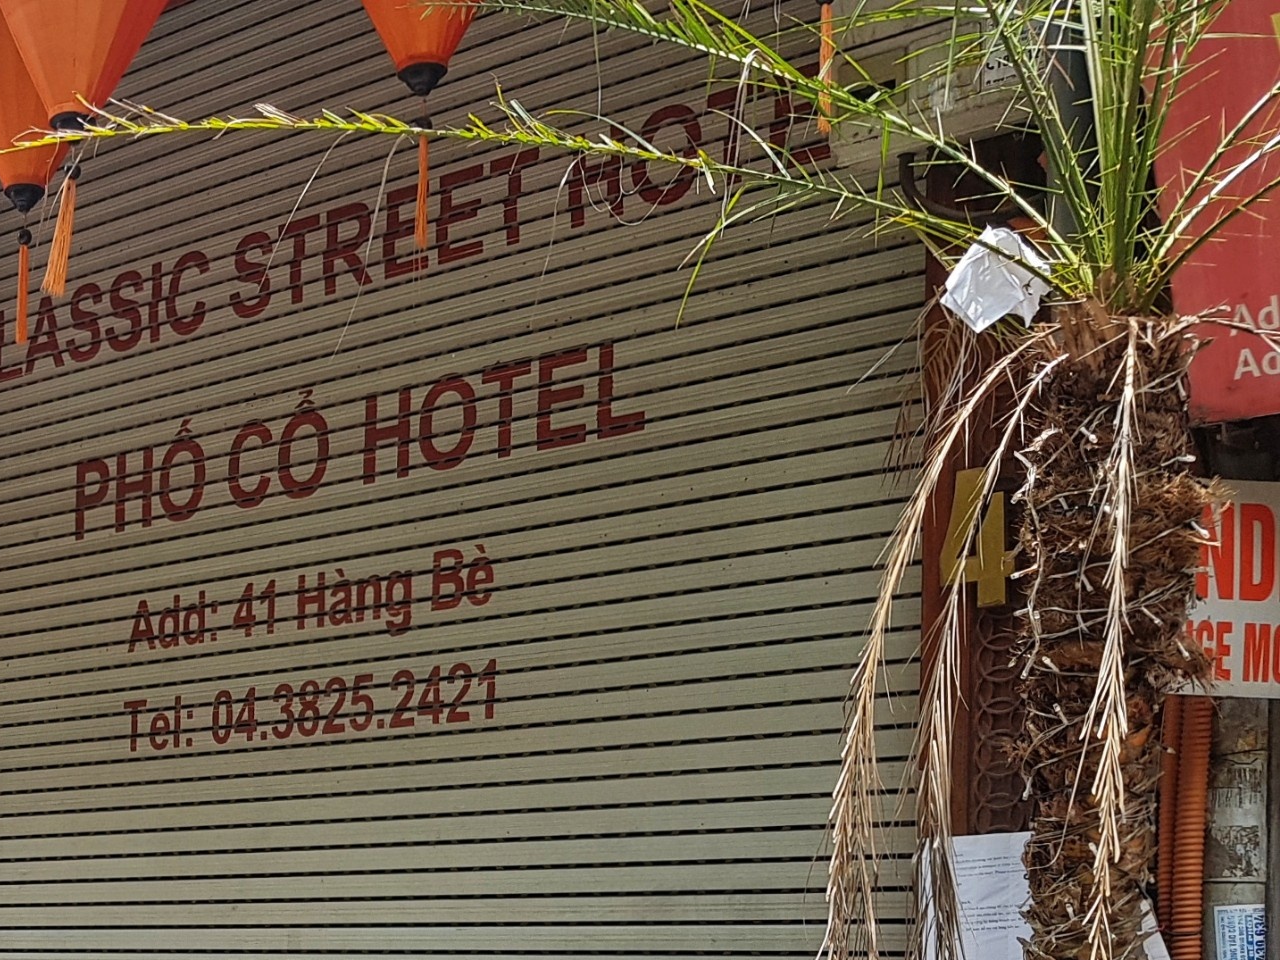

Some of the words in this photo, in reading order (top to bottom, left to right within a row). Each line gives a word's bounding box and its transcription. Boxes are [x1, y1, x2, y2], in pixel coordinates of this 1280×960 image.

[230, 146, 542, 319] STREET
[72, 417, 207, 541] PHỐ
[228, 387, 330, 510] CỔ
[361, 341, 647, 485] HOTEL
[128, 582, 219, 655] Add:
[232, 580, 278, 636] 41
[297, 566, 414, 637] Hàng
[431, 542, 496, 611] Bè
[123, 697, 195, 752] Tel:
[211, 658, 500, 746] 04.3825.2421
